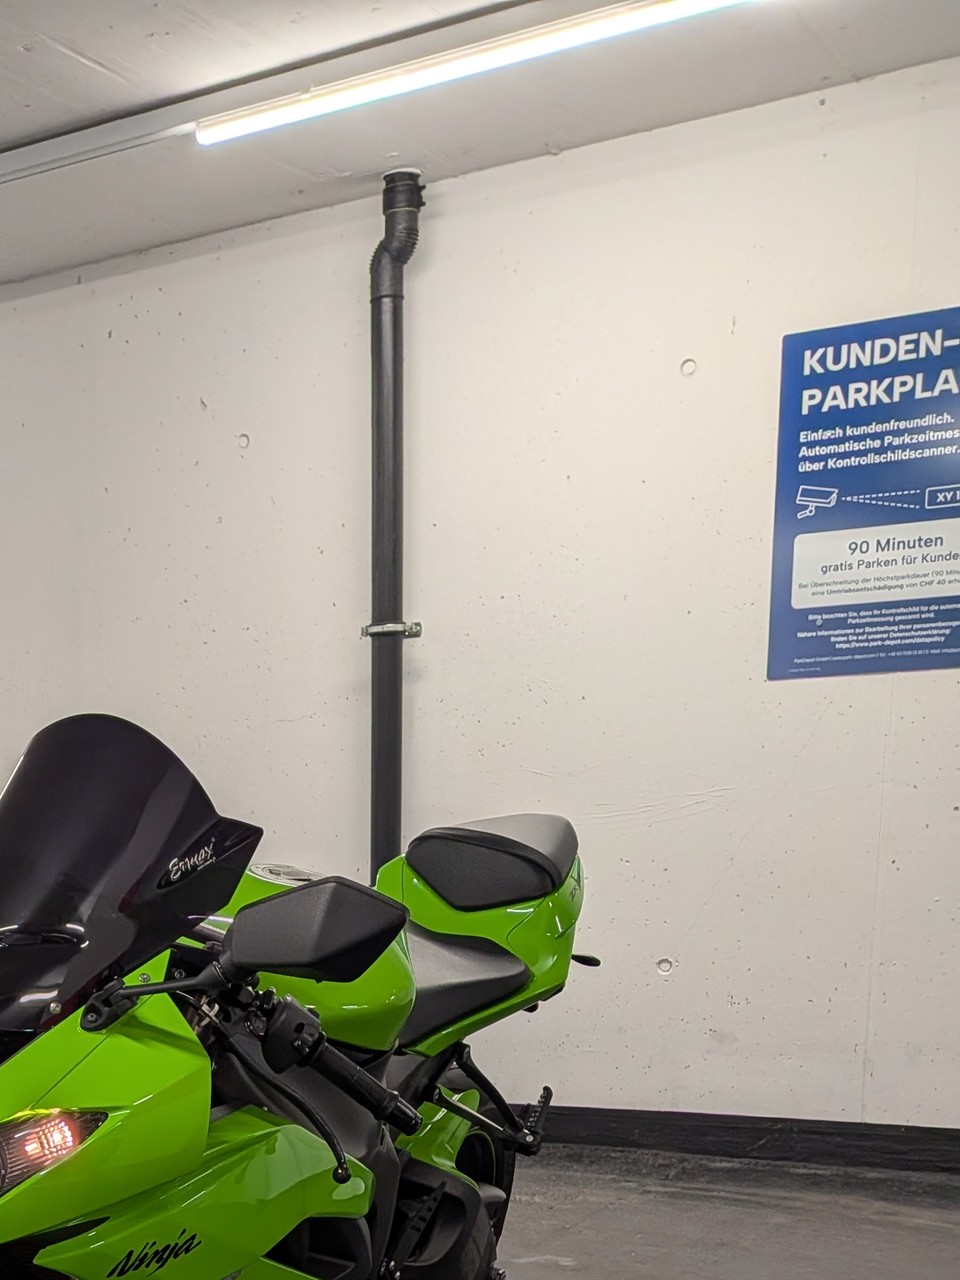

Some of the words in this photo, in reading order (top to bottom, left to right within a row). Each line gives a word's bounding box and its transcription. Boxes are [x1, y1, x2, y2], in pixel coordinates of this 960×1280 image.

[803, 329, 960, 376] KUNDEN-
[799, 427, 843, 443] Einfach
[846, 412, 955, 436] kundenfreundlich.
[798, 438, 882, 458] Automatische
[798, 460, 826, 473] über
[827, 445, 960, 470] Kontrollschildscanner.
[936, 491, 954, 503] XY
[848, 540, 870, 556] 90
[876, 535, 944, 553] Minuten
[820, 560, 853, 575] gratis
[857, 557, 898, 570] Parken
[901, 554, 918, 566] für
[921, 550, 960, 564] Kunde
[105, 1227, 202, 1279] Ninja
